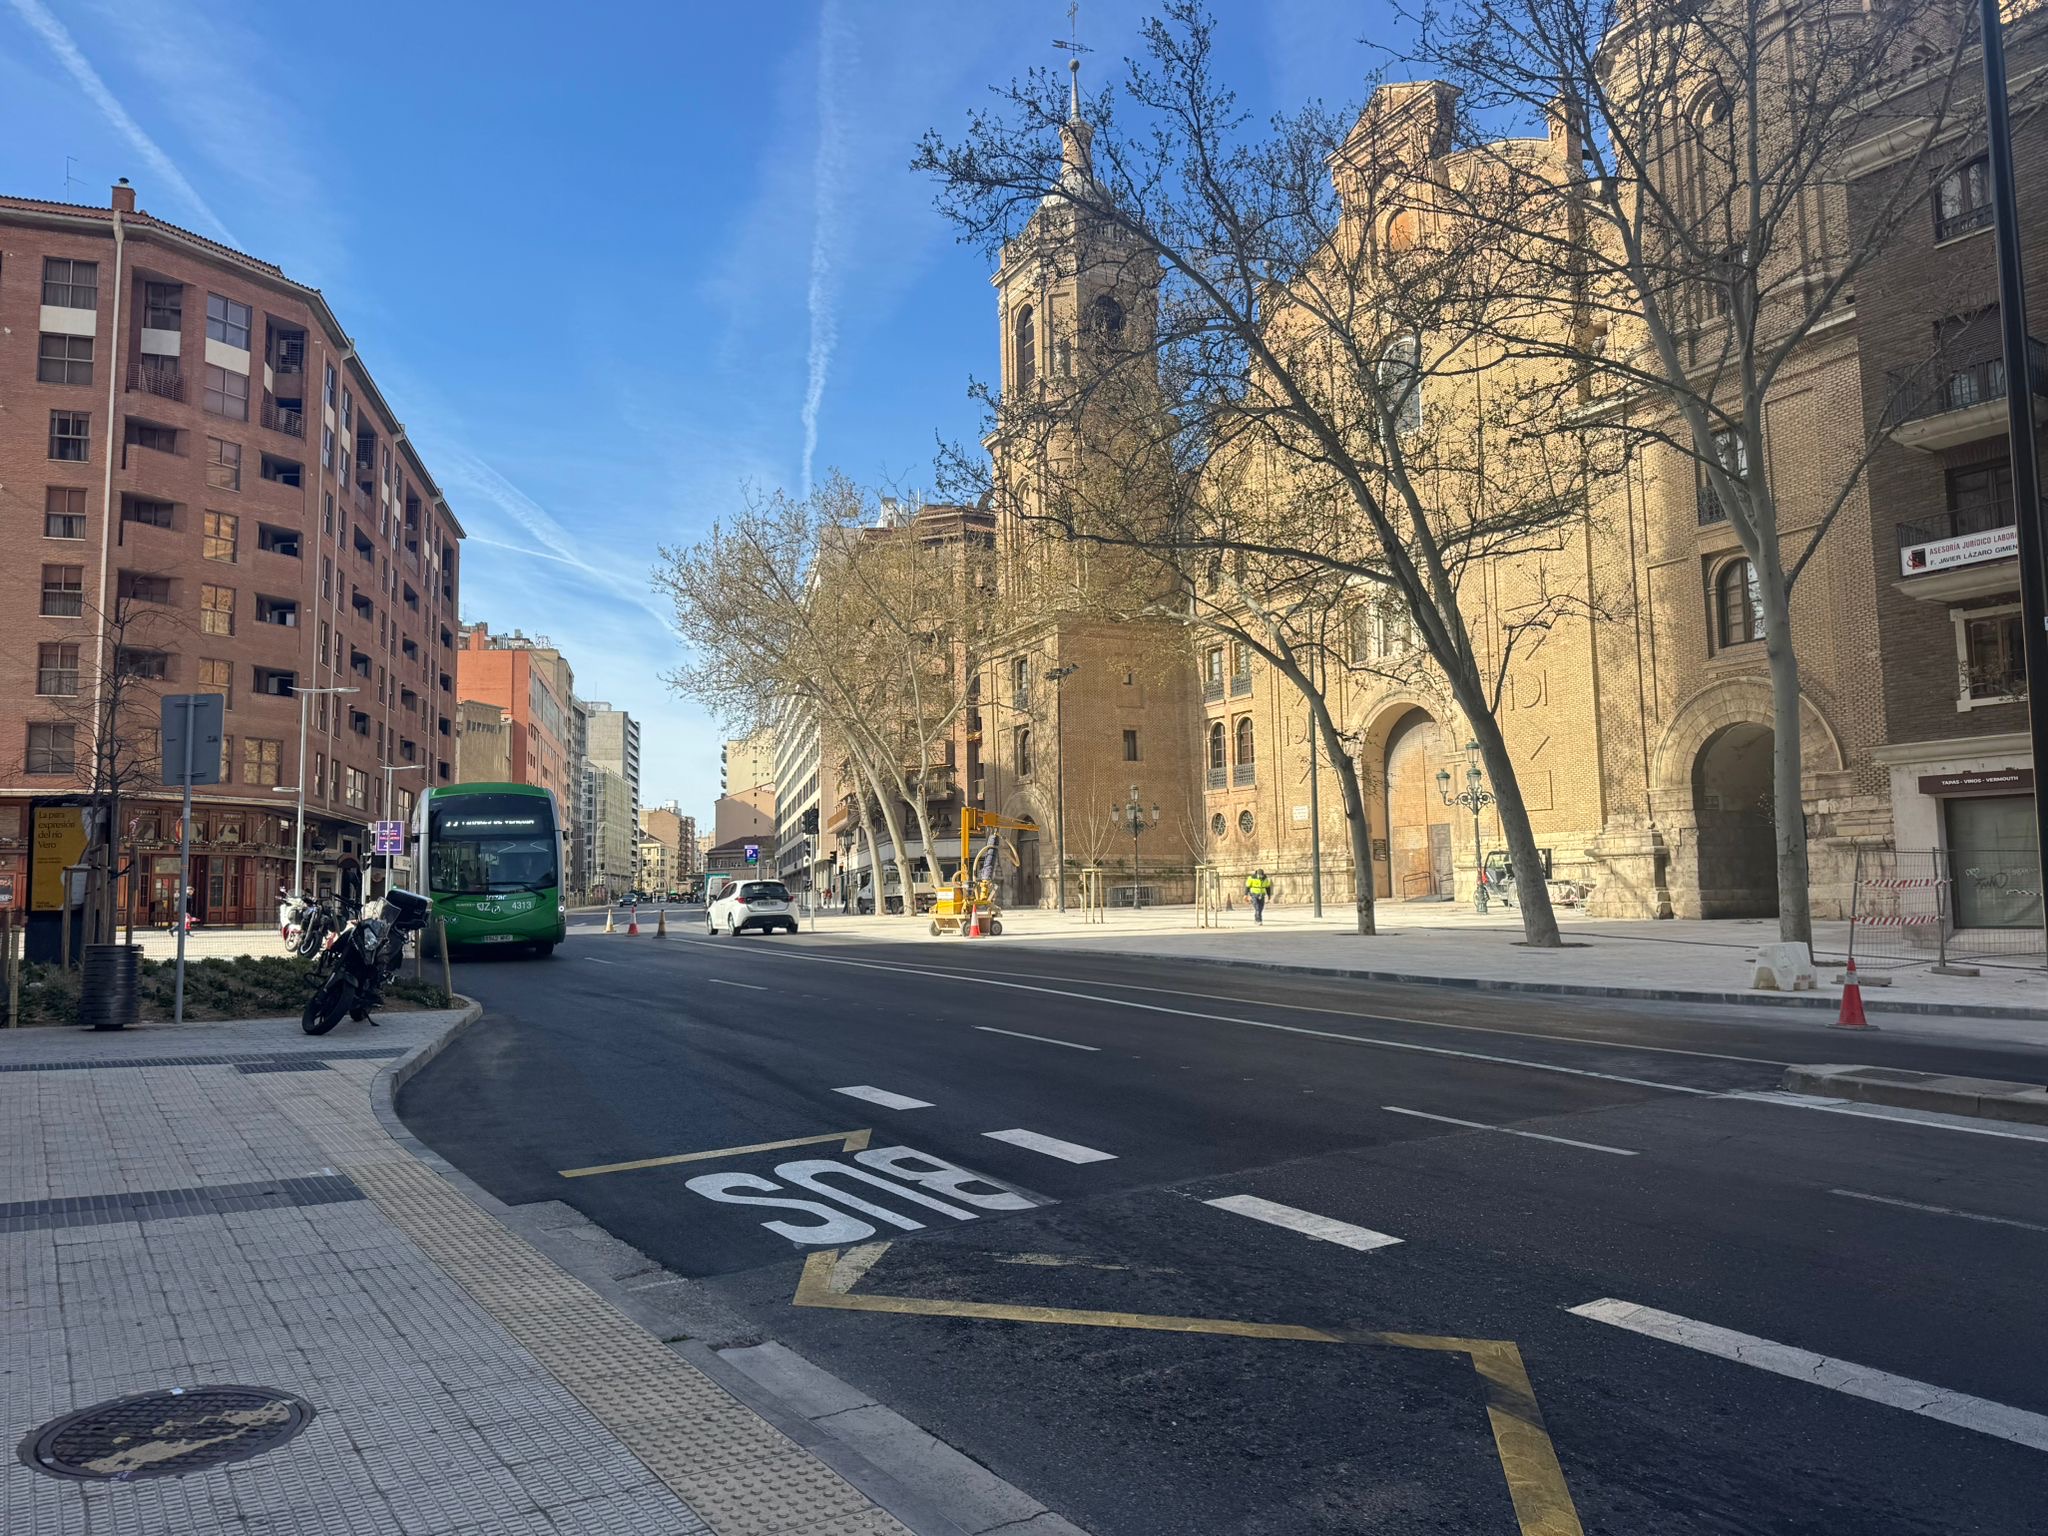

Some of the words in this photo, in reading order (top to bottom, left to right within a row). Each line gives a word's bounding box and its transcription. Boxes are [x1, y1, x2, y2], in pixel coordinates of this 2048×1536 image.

[1929, 542, 1961, 556] ASESORÍA
[1962, 536, 1992, 549] JURÍDICO
[1938, 555, 1961, 565] JAVIER
[1963, 549, 1993, 559] LÁZARO
[38, 811, 48, 819] La
[38, 820, 75, 830] expresión
[38, 830, 50, 838] del
[38, 841, 56, 849] Vero
[746, 849, 754, 857] P
[511, 901, 532, 910] 4313
[684, 1145, 1062, 1245] BUS
